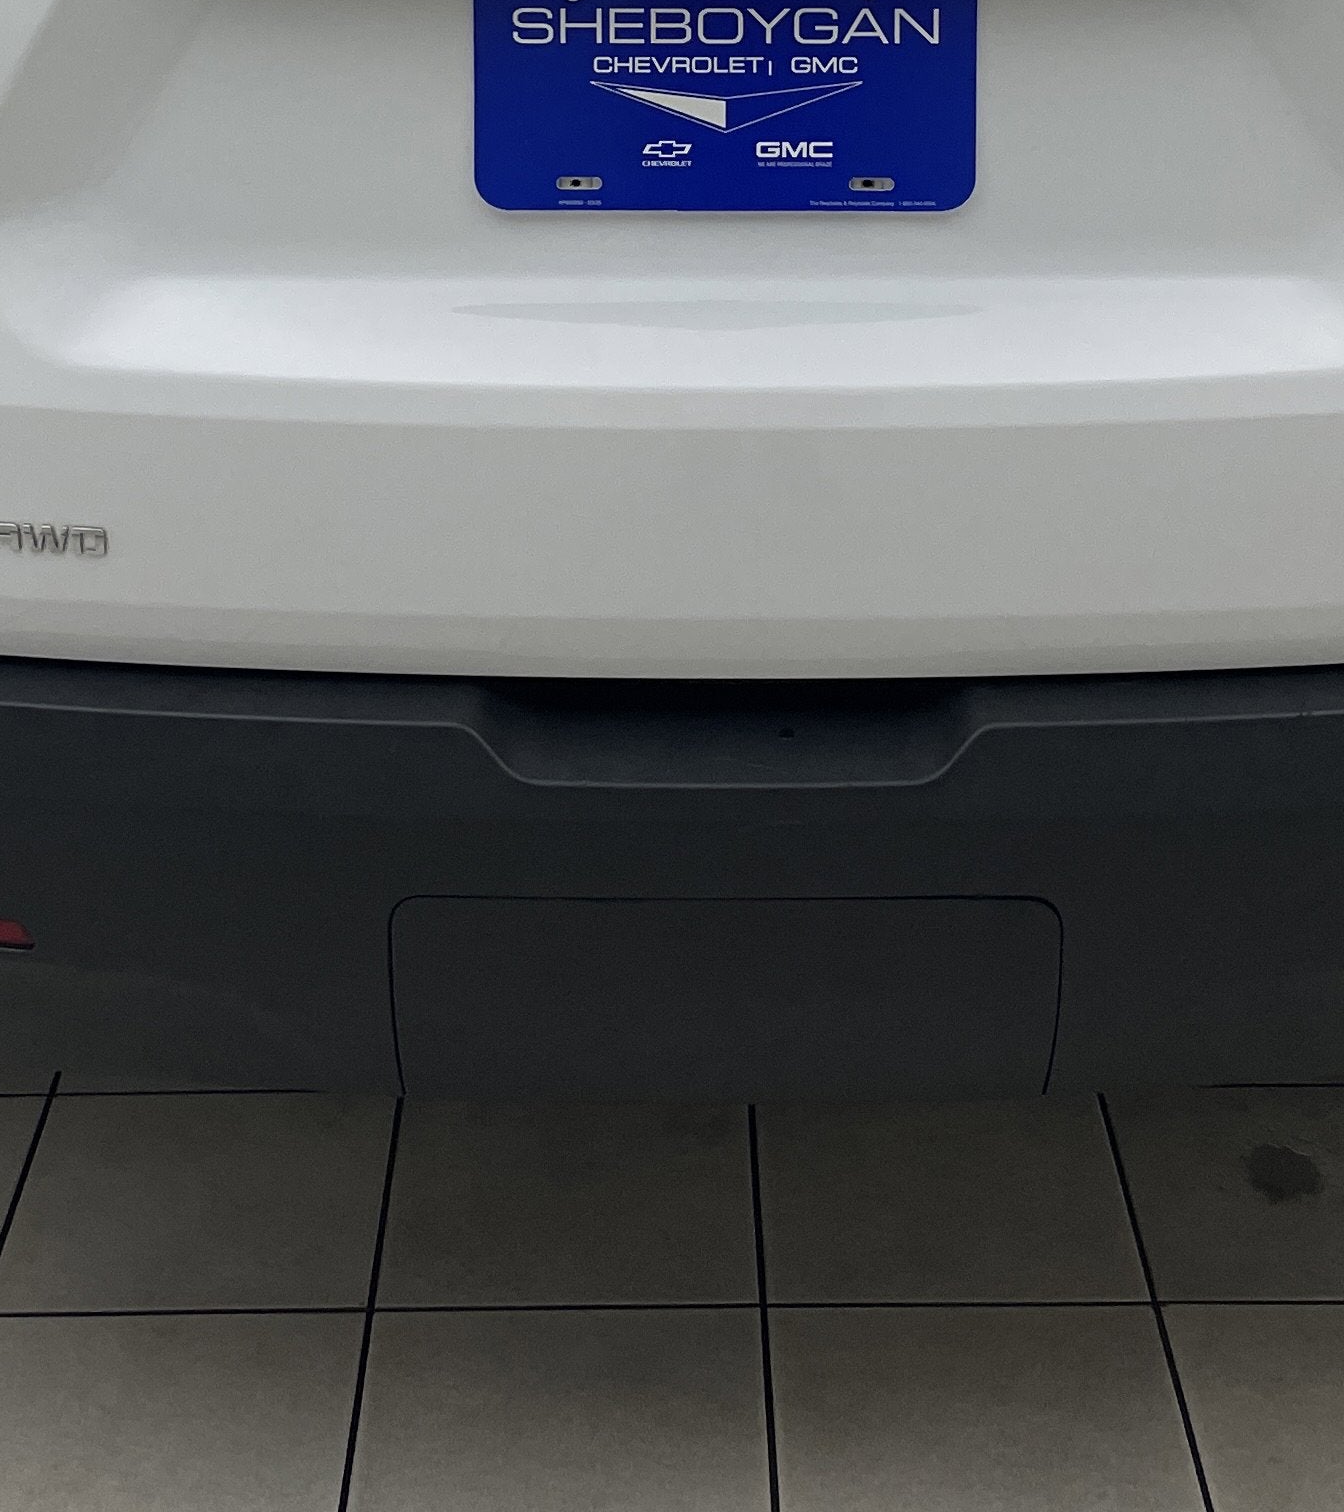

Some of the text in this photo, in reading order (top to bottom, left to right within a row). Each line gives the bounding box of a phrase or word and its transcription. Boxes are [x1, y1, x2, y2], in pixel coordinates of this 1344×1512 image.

[511, 7, 941, 45] SHEBOYGAN
[592, 56, 859, 74] CHEVROLET GMC
[756, 141, 833, 158] GMC
